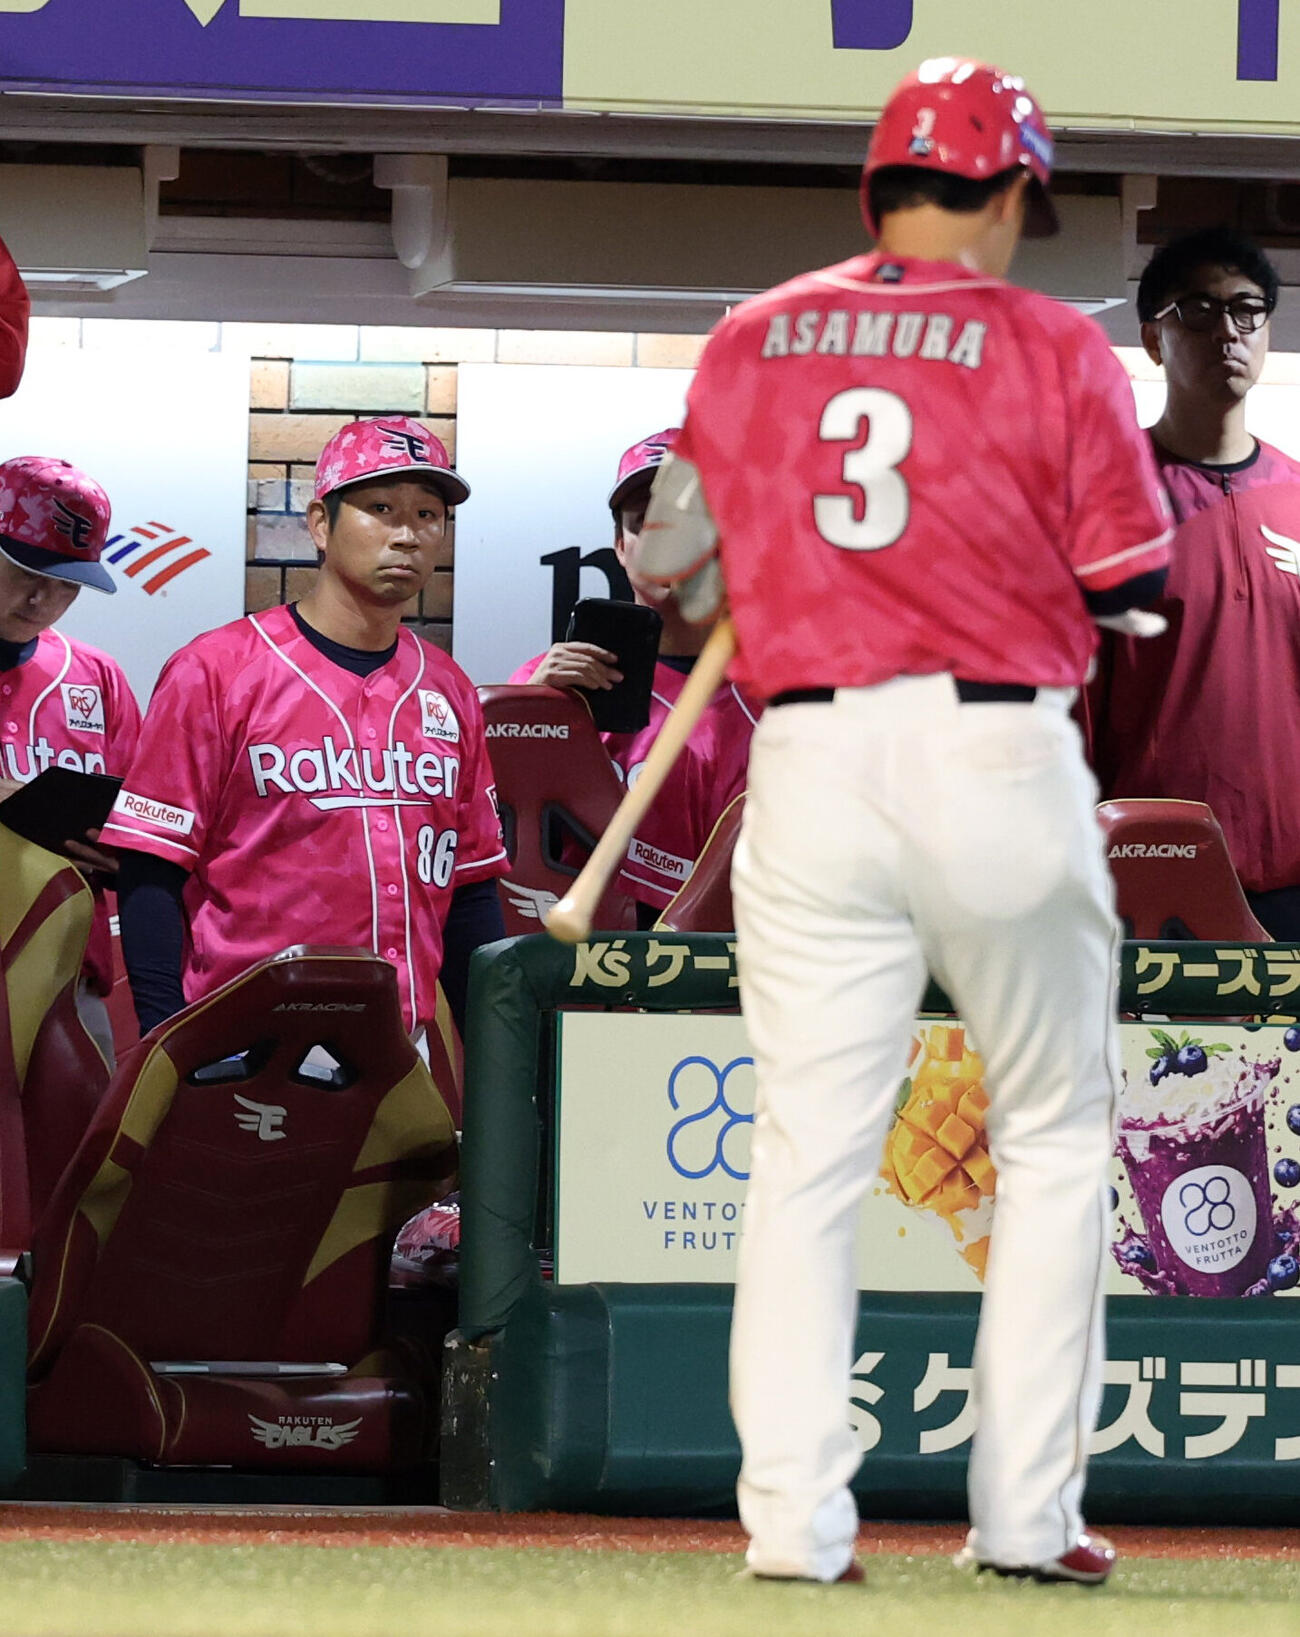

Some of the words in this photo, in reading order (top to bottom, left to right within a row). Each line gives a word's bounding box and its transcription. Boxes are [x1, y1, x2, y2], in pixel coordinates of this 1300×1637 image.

[761, 310, 988, 369] ASAMURA
[812, 386, 914, 551] 3
[485, 723, 569, 739] AKRACING
[248, 736, 460, 799] Rakuten
[124, 795, 185, 826] Rakuten
[416, 825, 459, 888] 86
[634, 843, 684, 875] Rakuten
[1108, 843, 1197, 859] AKRACING
[645, 939, 739, 988] ケー
[643, 1201, 746, 1221] VENTO
[664, 1231, 736, 1250] FRUT
[1185, 1229, 1248, 1254] VENTOTTO
[1195, 1246, 1242, 1265] FRUTTA
[278, 1416, 333, 1425] RAKUTEN
